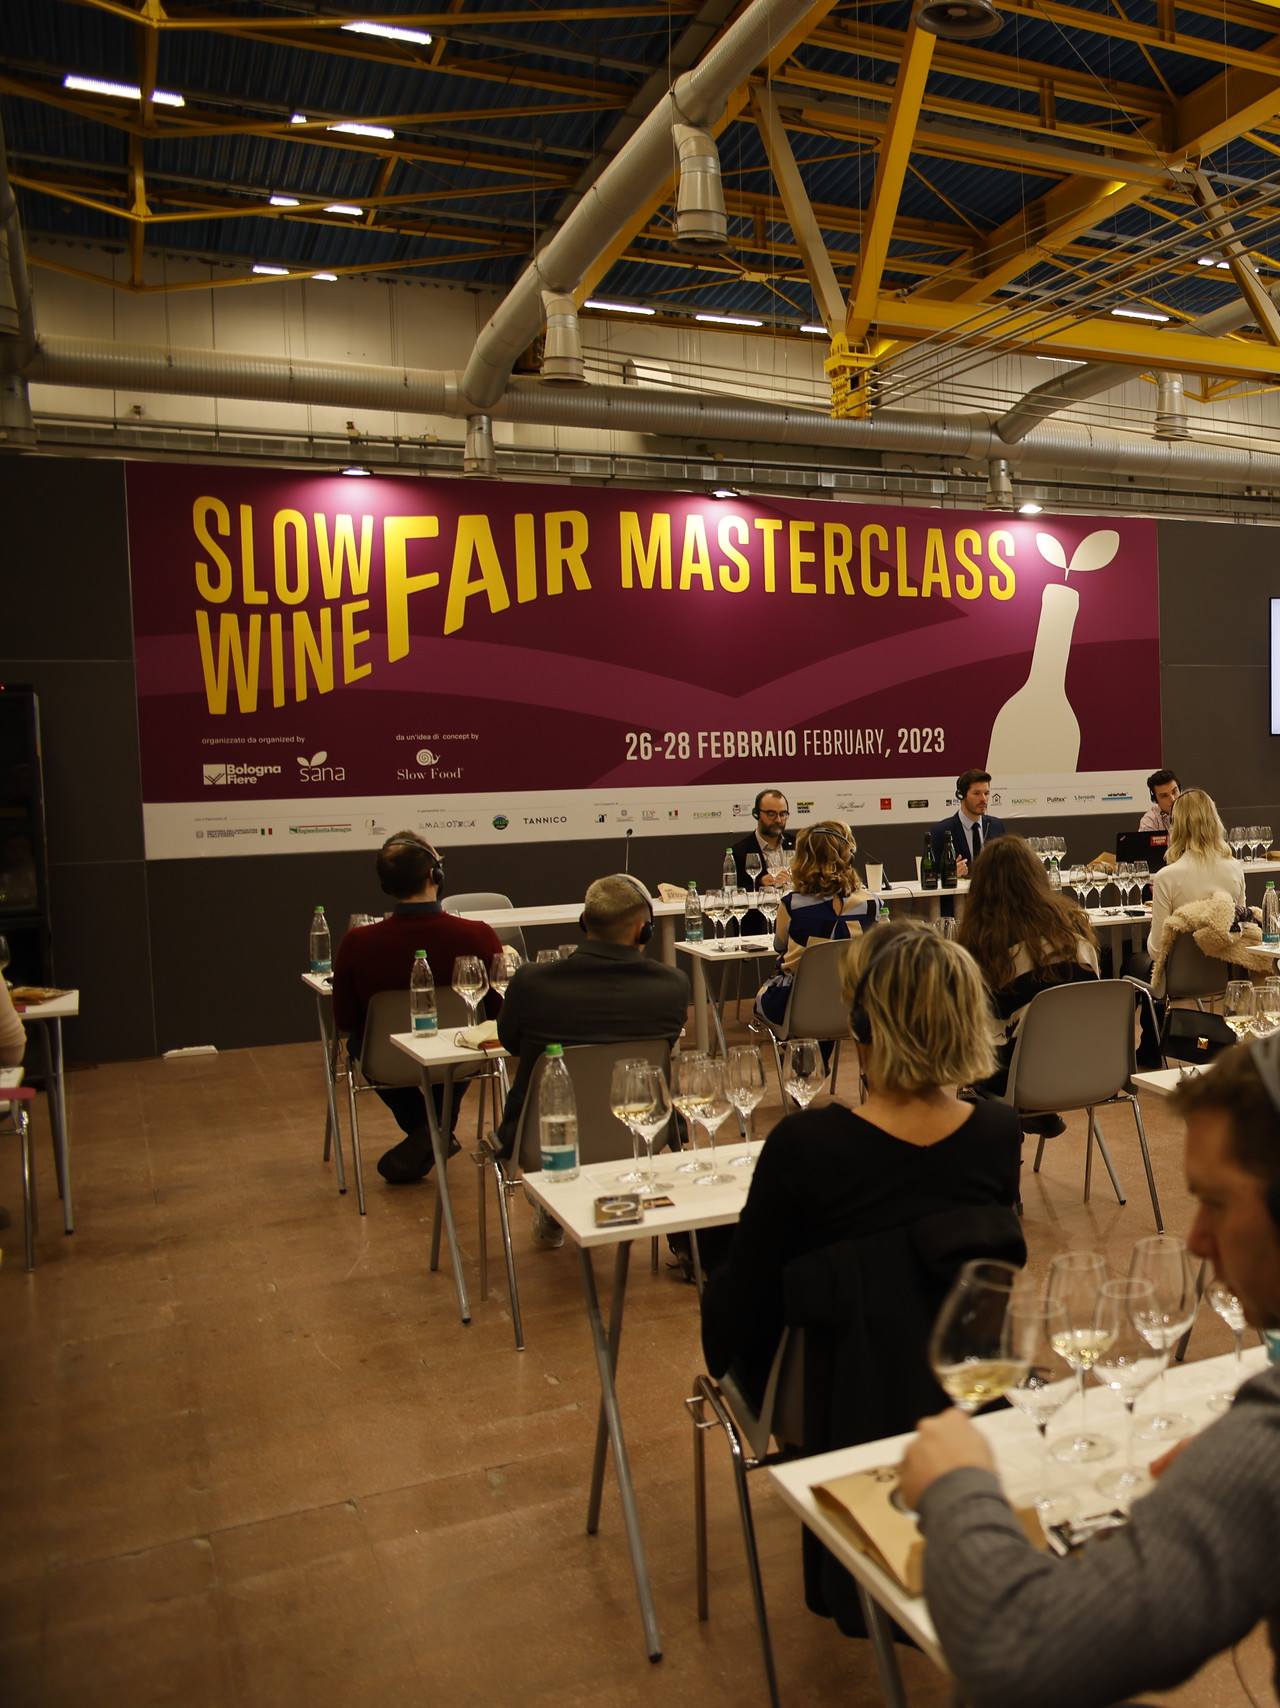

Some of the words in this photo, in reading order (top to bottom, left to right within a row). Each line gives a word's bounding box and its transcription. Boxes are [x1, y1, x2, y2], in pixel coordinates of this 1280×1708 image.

[193, 496, 374, 605] SLOW
[383, 510, 592, 663] FAIR
[619, 511, 1016, 601] MASTERCLASS
[195, 599, 373, 716] WINE
[202, 737, 246, 745] organizzato
[258, 736, 295, 744] organized
[296, 736, 305, 744] by
[406, 733, 432, 741] un'idea
[442, 733, 470, 741] concept
[625, 732, 690, 761] 26-28
[698, 730, 797, 759] FEBBRAIO
[803, 728, 891, 758] FEBRUARY,
[898, 727, 945, 753] 2023
[226, 763, 281, 776] Bologna
[300, 767, 345, 782] sana
[397, 769, 427, 780] Slow
[431, 768, 461, 779] Food
[227, 775, 258, 784] Fiere
[523, 816, 568, 825] TANNICO
